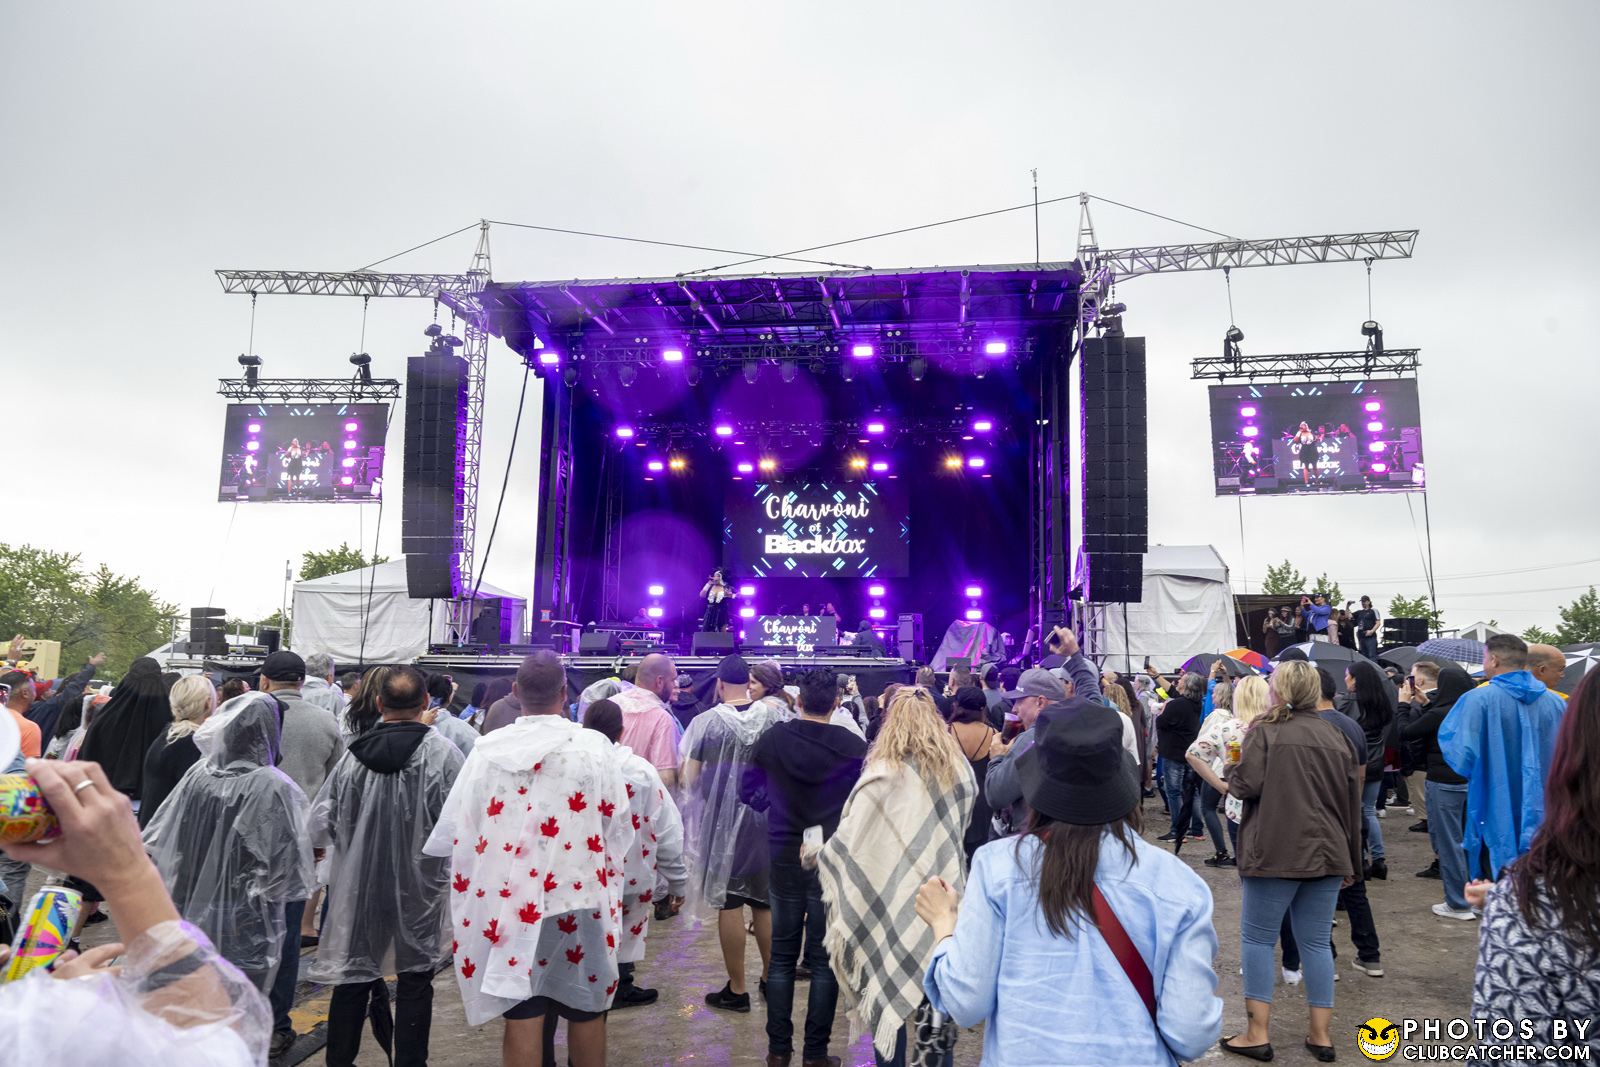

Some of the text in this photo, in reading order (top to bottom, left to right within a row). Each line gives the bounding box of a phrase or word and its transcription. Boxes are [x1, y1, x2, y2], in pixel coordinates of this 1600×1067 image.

[765, 495, 870, 521] Charvoni
[808, 522, 822, 532] of
[764, 532, 867, 554] Blackbox
[763, 619, 817, 635] Charvoni
